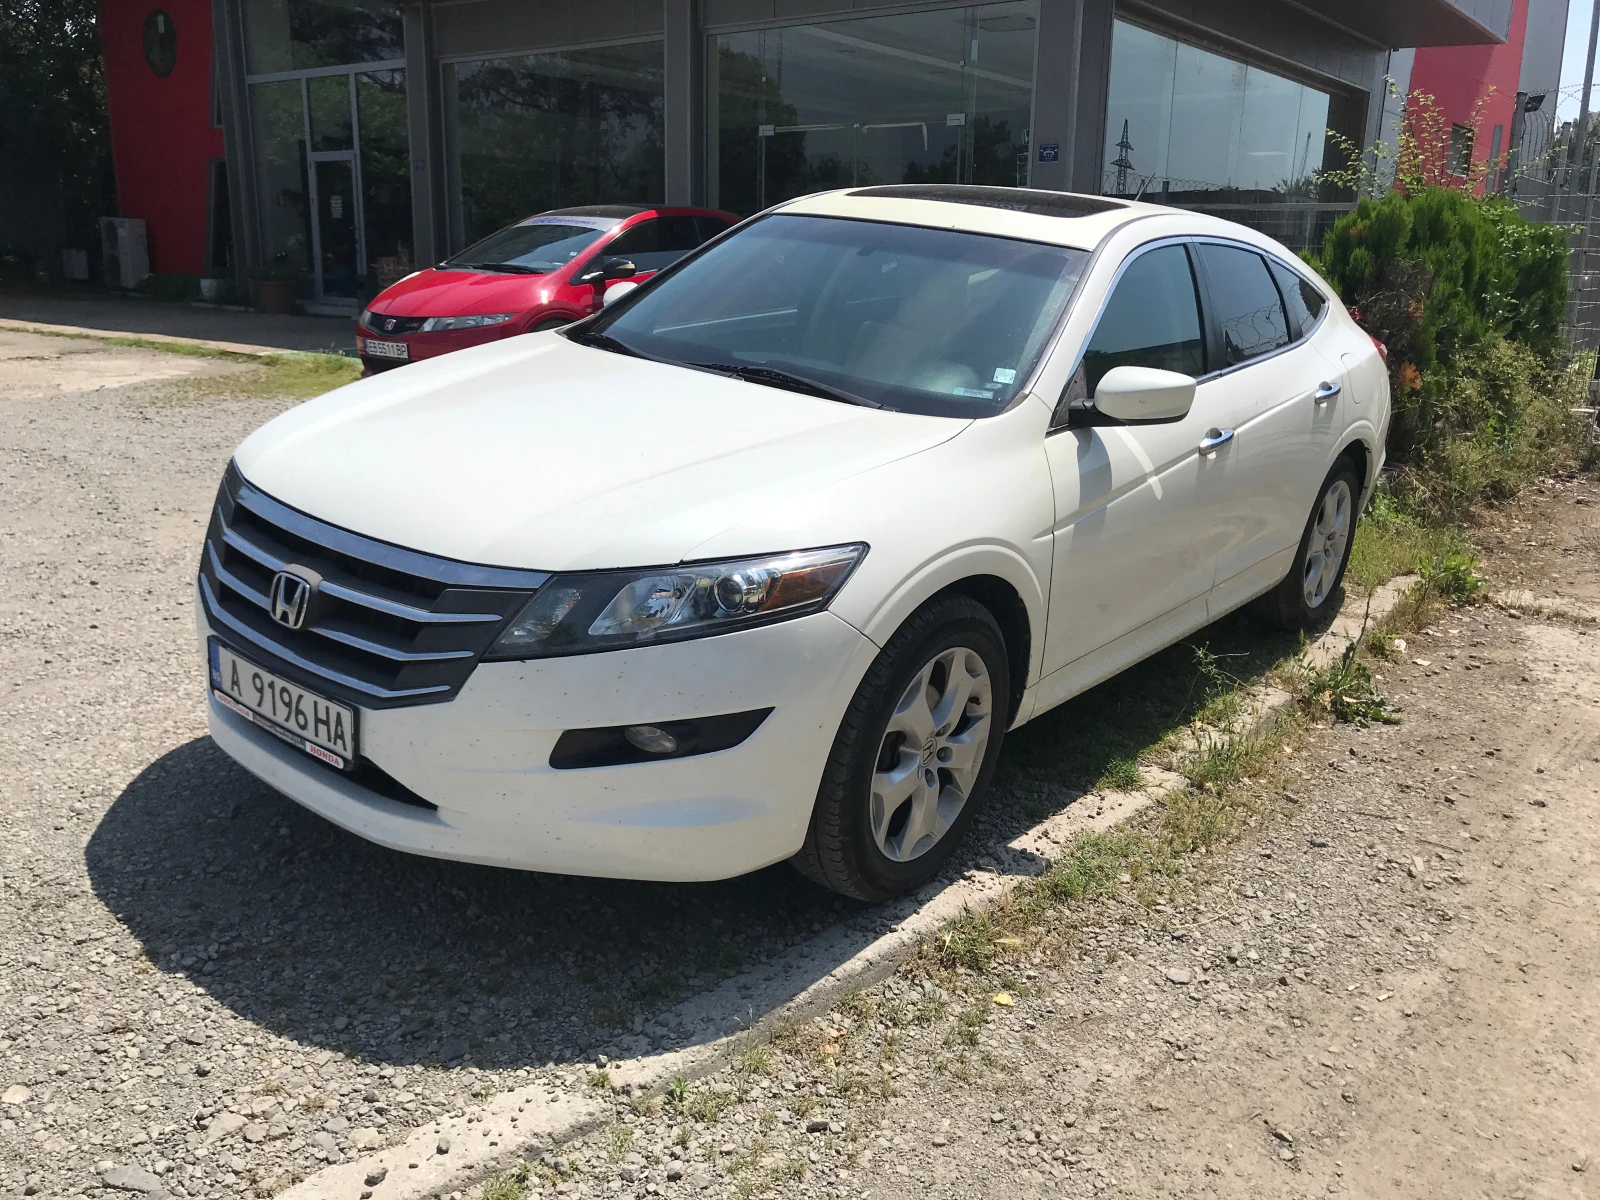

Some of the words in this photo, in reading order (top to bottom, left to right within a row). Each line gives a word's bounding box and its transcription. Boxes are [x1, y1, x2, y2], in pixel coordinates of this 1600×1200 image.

[230, 658, 243, 698] A
[252, 672, 308, 731] 9196
[313, 700, 348, 752] HA
[310, 744, 341, 767] HONDA
